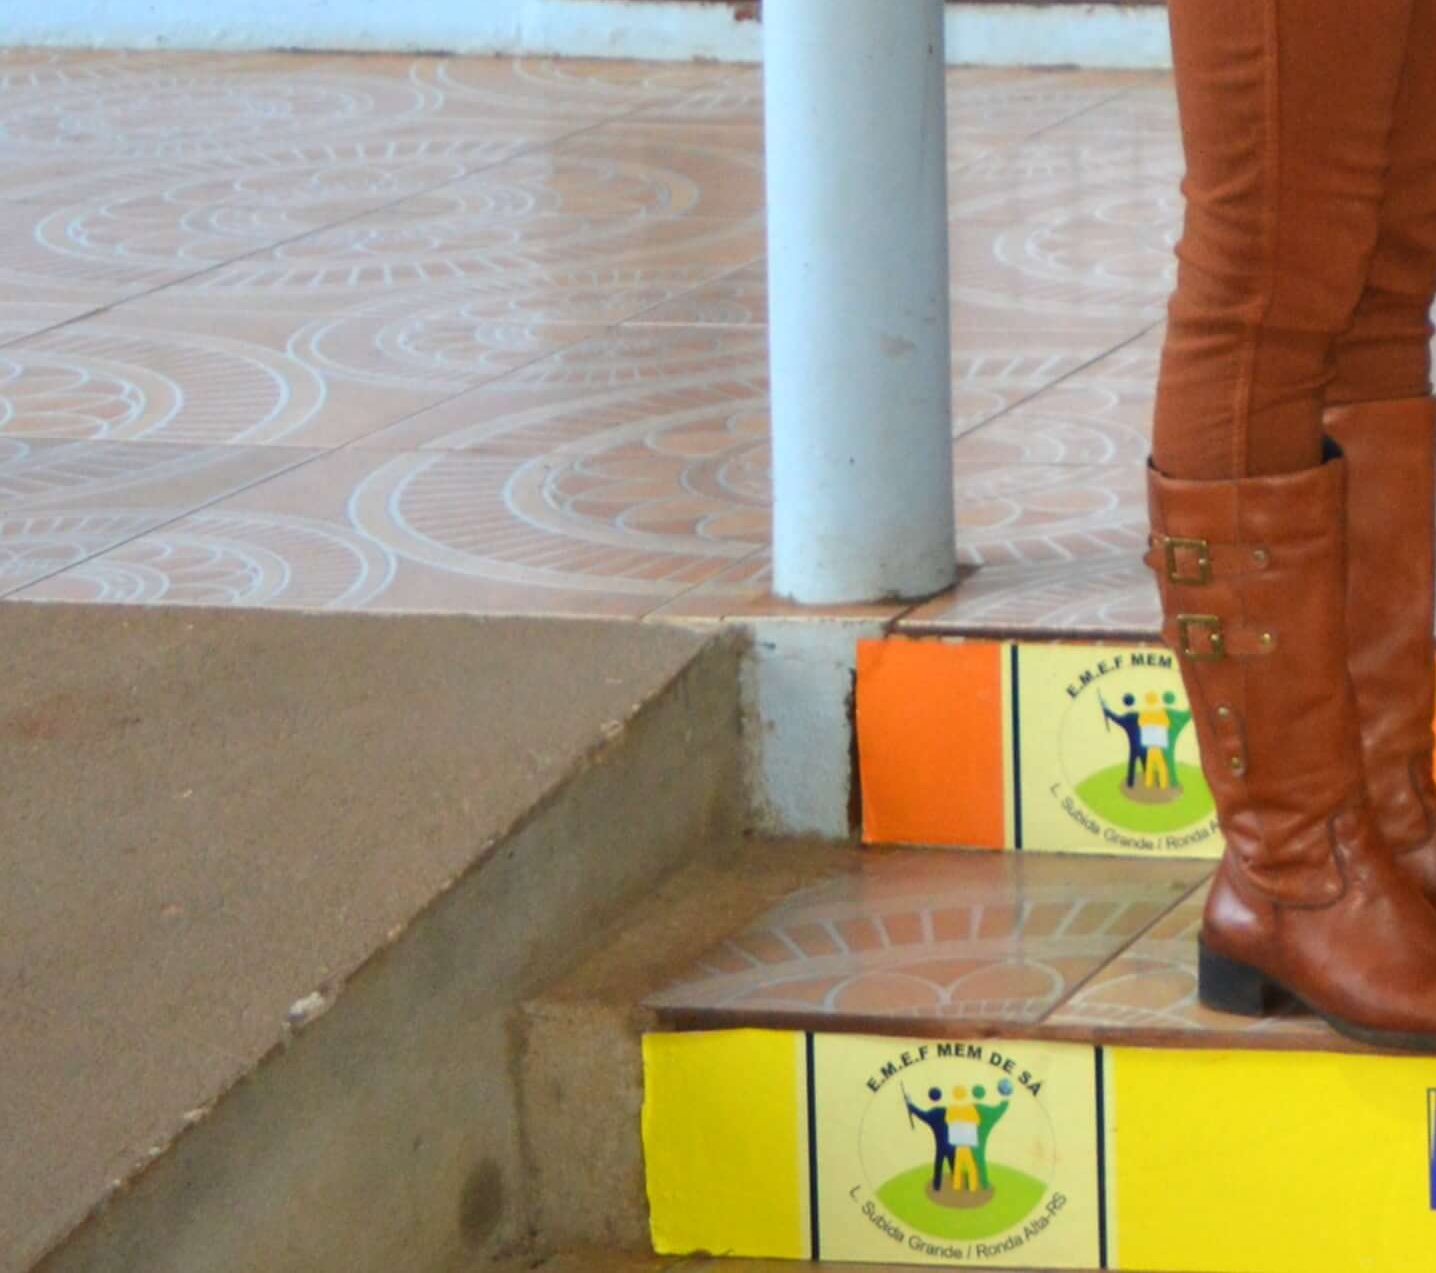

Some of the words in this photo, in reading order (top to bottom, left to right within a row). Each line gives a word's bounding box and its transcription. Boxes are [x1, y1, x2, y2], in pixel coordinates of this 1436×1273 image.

[1131, 653, 1172, 670] MEM
[1061, 797, 1100, 834] Subida
[1104, 828, 1154, 851] Grande
[1166, 829, 1210, 849] Ronda
[866, 1046, 928, 1093] E.M.E.F
[936, 1043, 983, 1060] MEM
[989, 1051, 1016, 1074] DE
[861, 1200, 905, 1243] Subida
[908, 1235, 964, 1259] Grande
[976, 1234, 1024, 1259] Ronda
